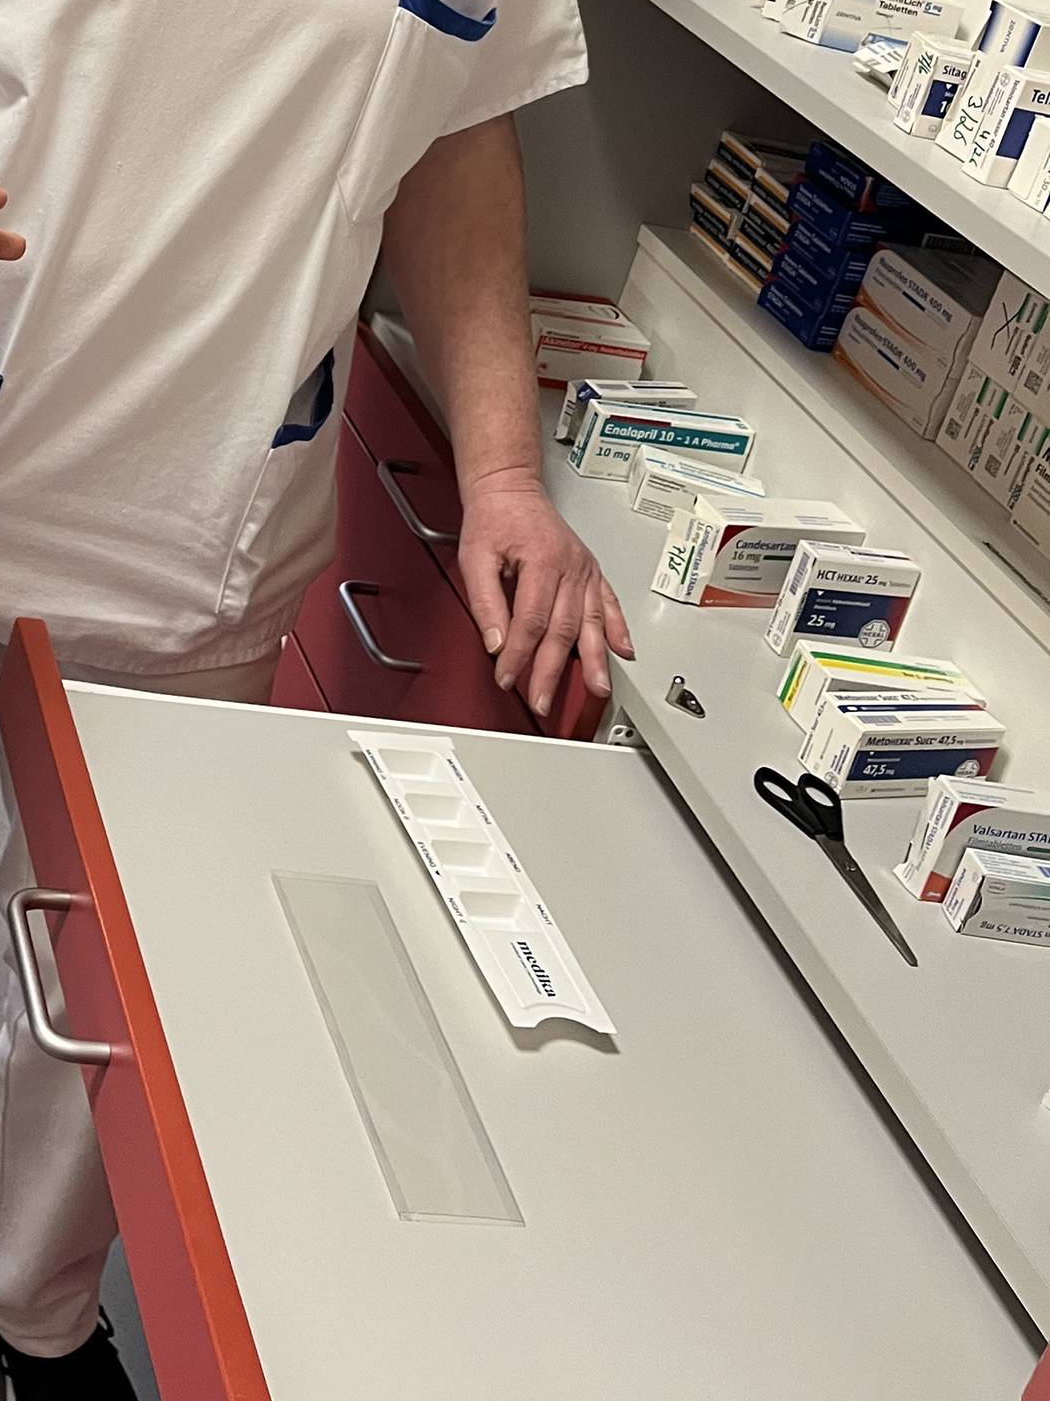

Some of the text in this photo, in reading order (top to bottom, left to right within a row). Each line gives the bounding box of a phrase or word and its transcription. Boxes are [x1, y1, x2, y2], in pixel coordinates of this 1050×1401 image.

[879, 0, 919, 16] Tabletten
[1031, 89, 1050, 105] Tel
[953, 95, 983, 147] 3/26
[907, 279, 929, 302] STADA
[882, 337, 902, 360] STADA
[604, 423, 658, 441] Enalapril
[659, 431, 675, 442] 10
[691, 437, 699, 445] A
[595, 447, 631, 462] 10 mg
[736, 540, 797, 551] Candesartan
[731, 552, 762, 564] 16 mg
[817, 569, 837, 581] HCT
[865, 575, 879, 585] 25
[807, 614, 825, 626] 25
[938, 735, 957, 746] 47,5
[862, 764, 885, 777] 47,5
[973, 824, 1027, 841] Valsartan
[967, 836, 1022, 852] Filmtabletten
[447, 897, 464, 917] NIGHT
[535, 903, 554, 926] NACHT
[979, 920, 1043, 939] mg 7,5 STADA
[516, 940, 556, 998] medika
